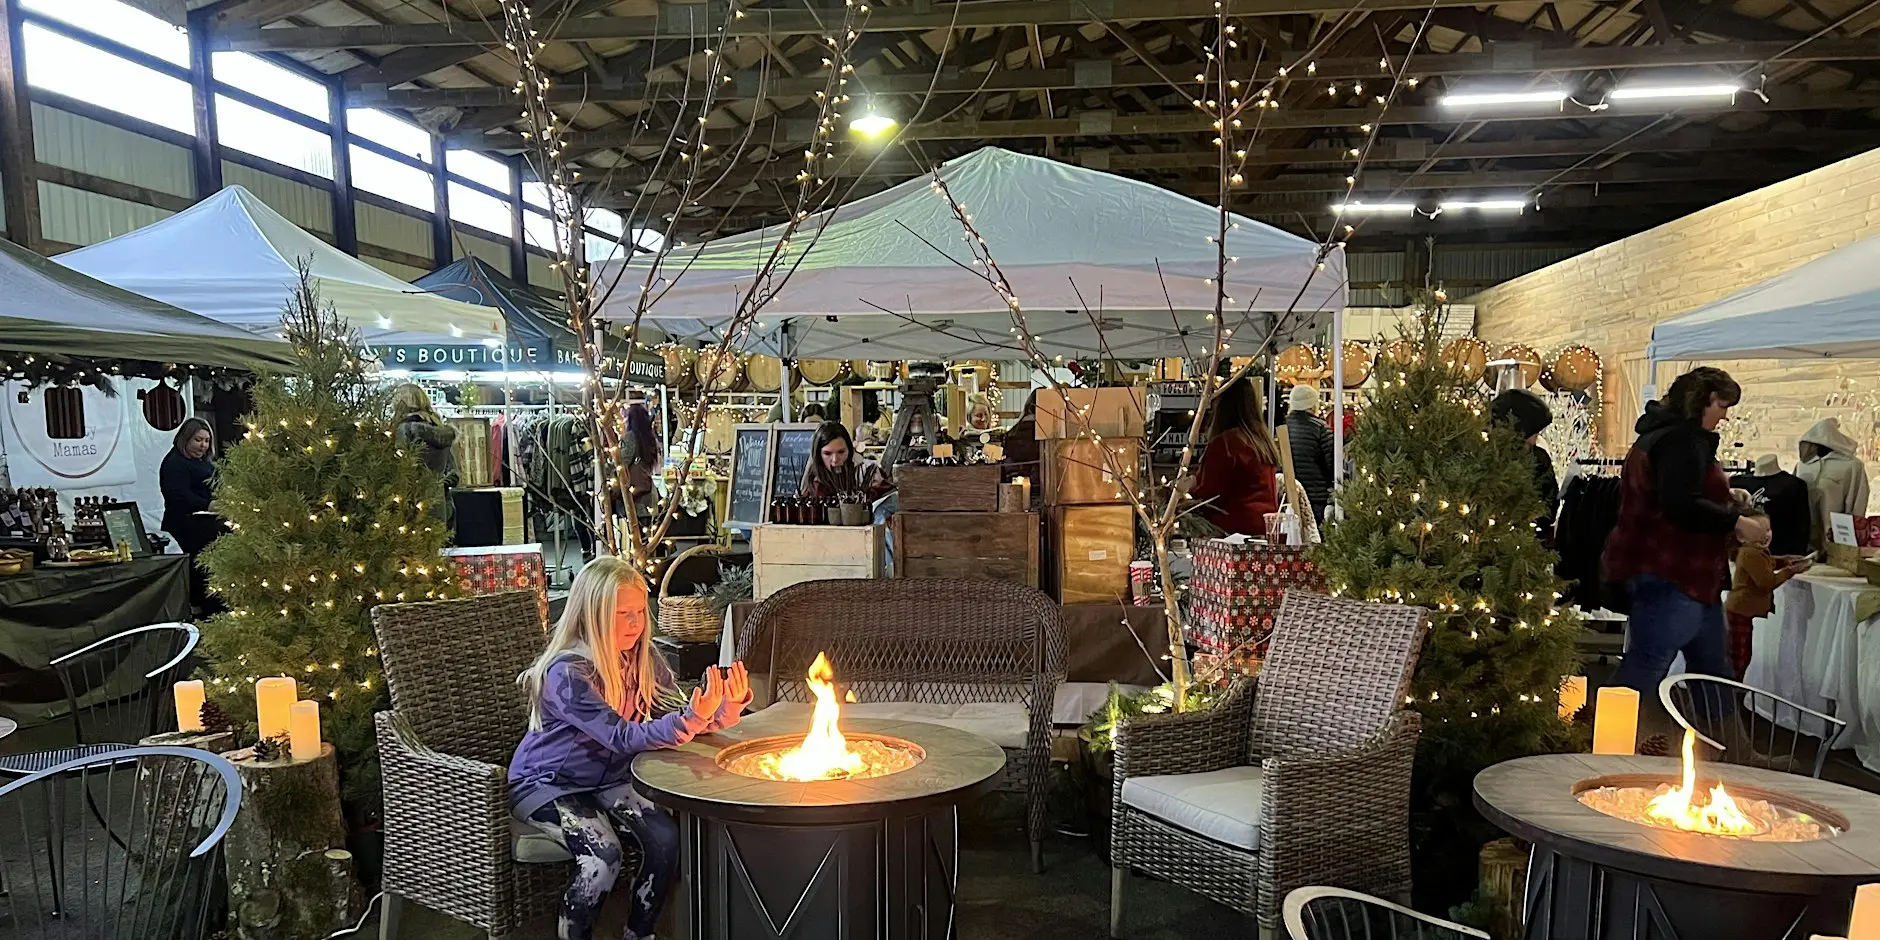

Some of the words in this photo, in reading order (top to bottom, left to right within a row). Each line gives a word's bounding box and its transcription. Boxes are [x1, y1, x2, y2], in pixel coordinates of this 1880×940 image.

[418, 348, 537, 363] BOUTIQUE
[629, 361, 664, 379] OUTIQUE
[1163, 384, 1194, 394] FOLLO
[53, 442, 98, 457] Mamas
